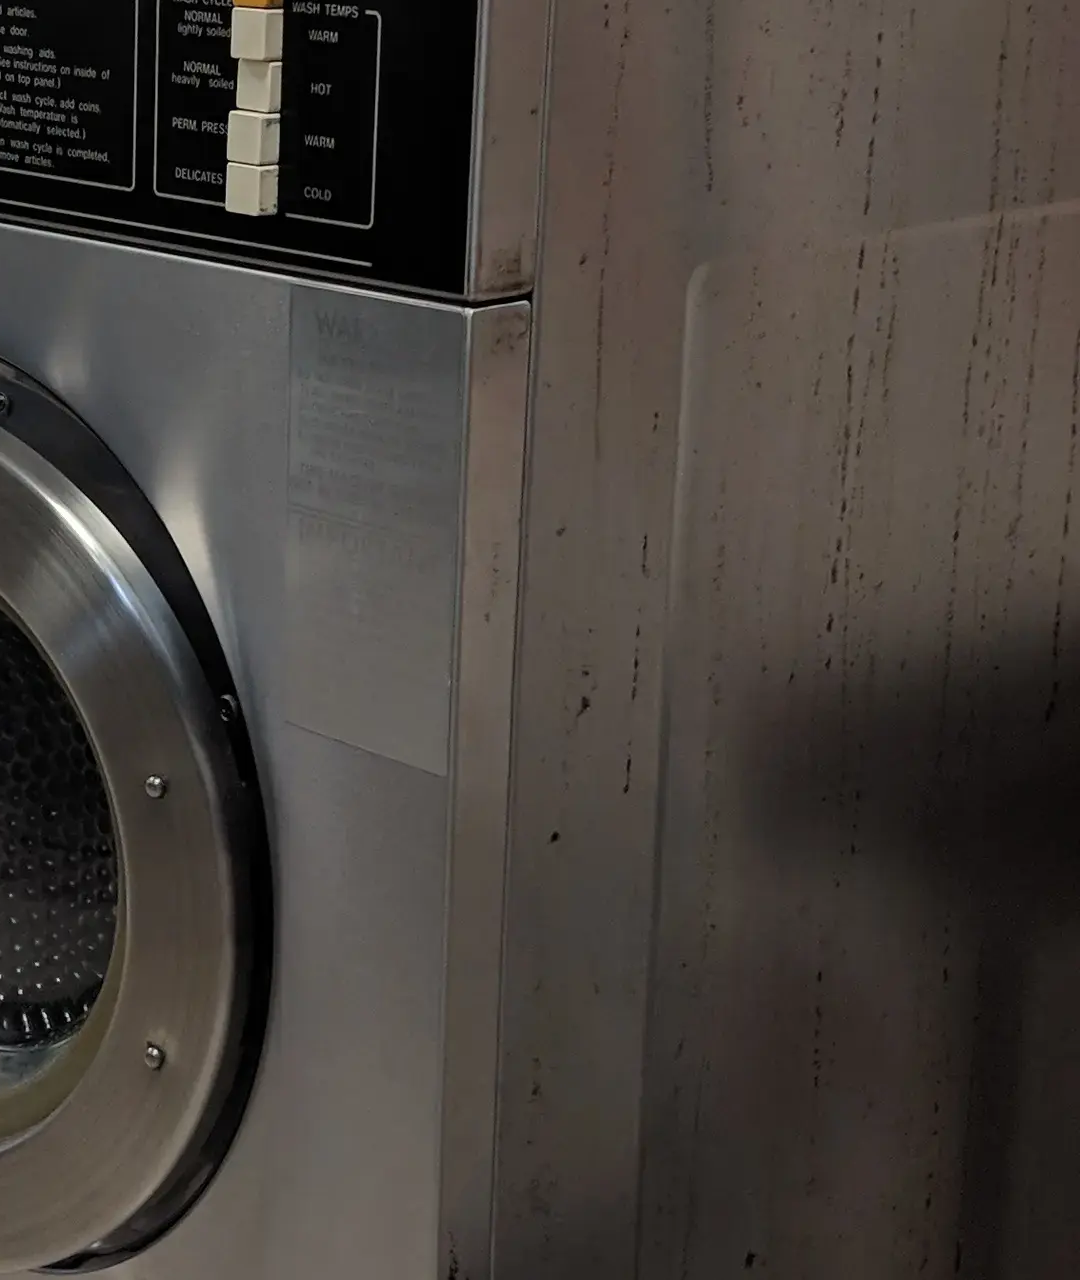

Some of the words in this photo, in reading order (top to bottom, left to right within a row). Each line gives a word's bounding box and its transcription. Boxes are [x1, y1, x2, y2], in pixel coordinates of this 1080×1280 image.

[184, 9, 223, 24] NORMAL
[292, 1, 320, 15] WASH
[325, 4, 359, 18] TEMPS
[177, 22, 203, 37] lightly
[206, 27, 232, 38] soiled
[308, 29, 339, 43] WARM
[3, 44, 33, 59] washing
[13, 58, 57, 74] instructions
[60, 65, 71, 75] on
[74, 64, 97, 79] inside
[101, 69, 110, 81] of
[183, 60, 222, 76] NORMAL
[5, 73, 15, 83] on
[18, 73, 30, 86] top
[171, 72, 201, 88] heavily
[208, 78, 234, 90] soiled
[310, 82, 332, 96] HOT
[12, 92, 31, 104] wash
[59, 98, 75, 110] add
[19, 106, 66, 123] temperature
[71, 113, 79, 124] is
[10, 138, 30, 150] wash
[32, 142, 53, 155] cycle
[56, 145, 63, 156] is
[304, 135, 335, 149] WARM
[175, 167, 223, 185] DELICATES
[304, 186, 332, 201] COLD
